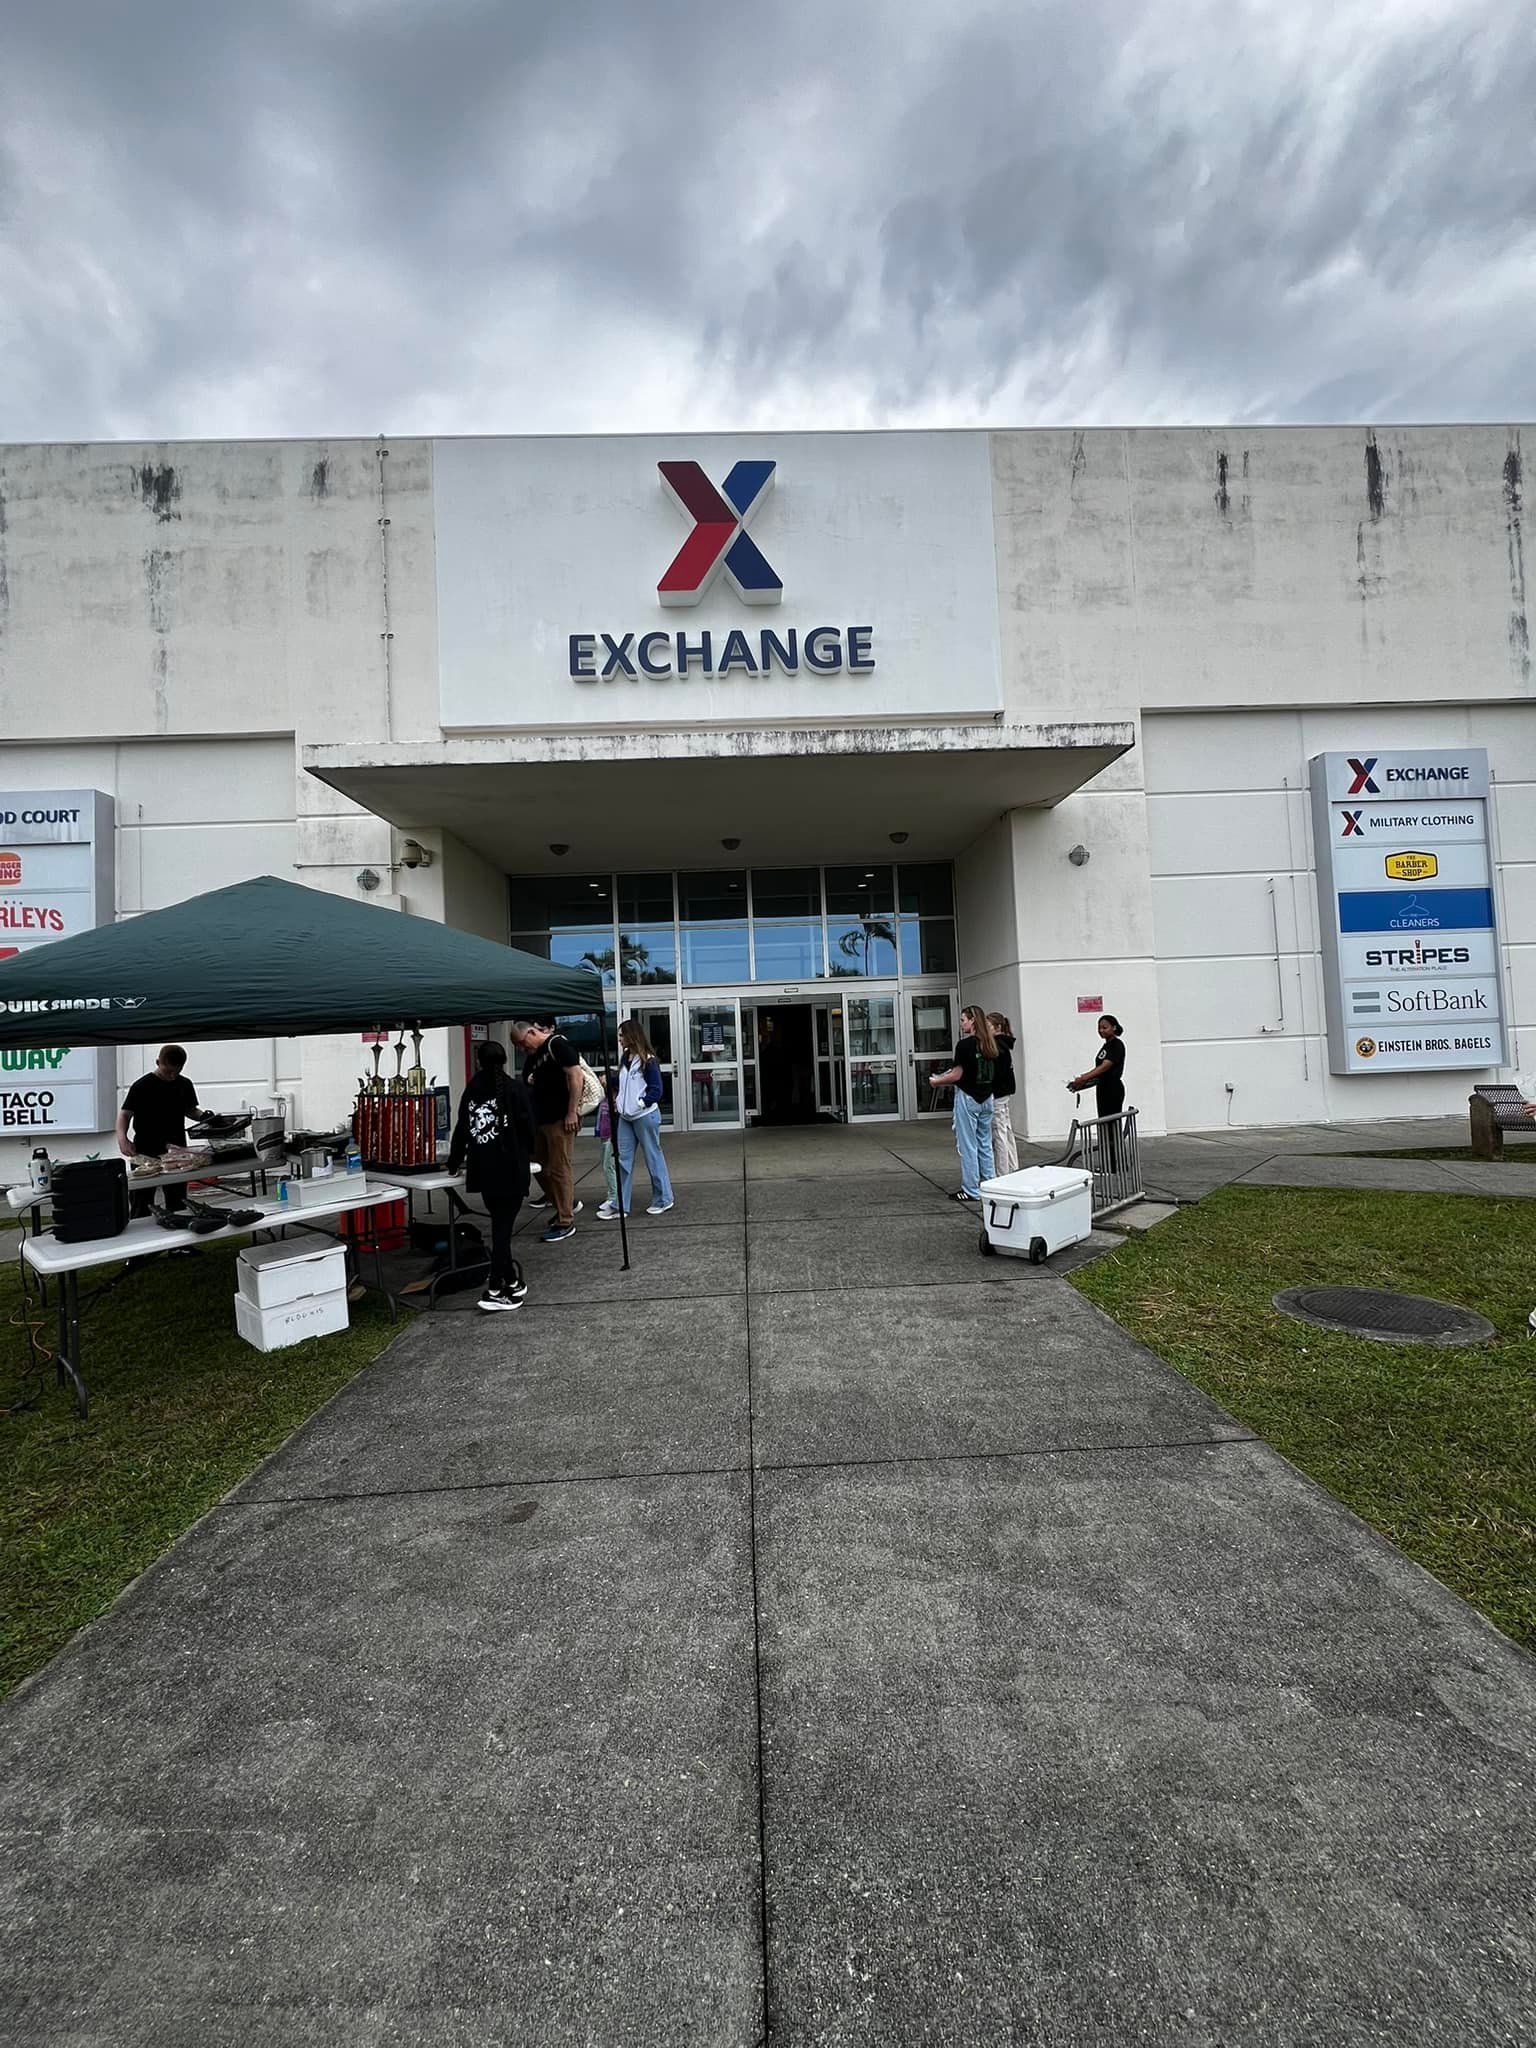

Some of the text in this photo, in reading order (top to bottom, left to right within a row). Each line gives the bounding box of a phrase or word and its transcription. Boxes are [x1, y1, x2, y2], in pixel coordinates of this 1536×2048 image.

[569, 626, 876, 680] EXCHANGE
[1386, 766, 1470, 782] EXCHANGE
[22, 809, 80, 825] COURT
[1370, 817, 1418, 828] MILITARY
[1421, 815, 1474, 826] CLOTHING
[1395, 860, 1428, 869] BARBER
[1401, 868, 1423, 877] SHOP
[1390, 918, 1440, 928] CLEANERS
[1366, 939, 1470, 966] STRIPES
[51, 998, 111, 1009] SHADE
[1387, 989, 1488, 1013] SoftBank
[1378, 1040, 1422, 1052] EINSTEIN
[1425, 1039, 1451, 1051] BROS.
[1455, 1037, 1491, 1049] BAGELS
[0, 1091, 54, 1109] TACO
[3, 1108, 55, 1126] BELL
